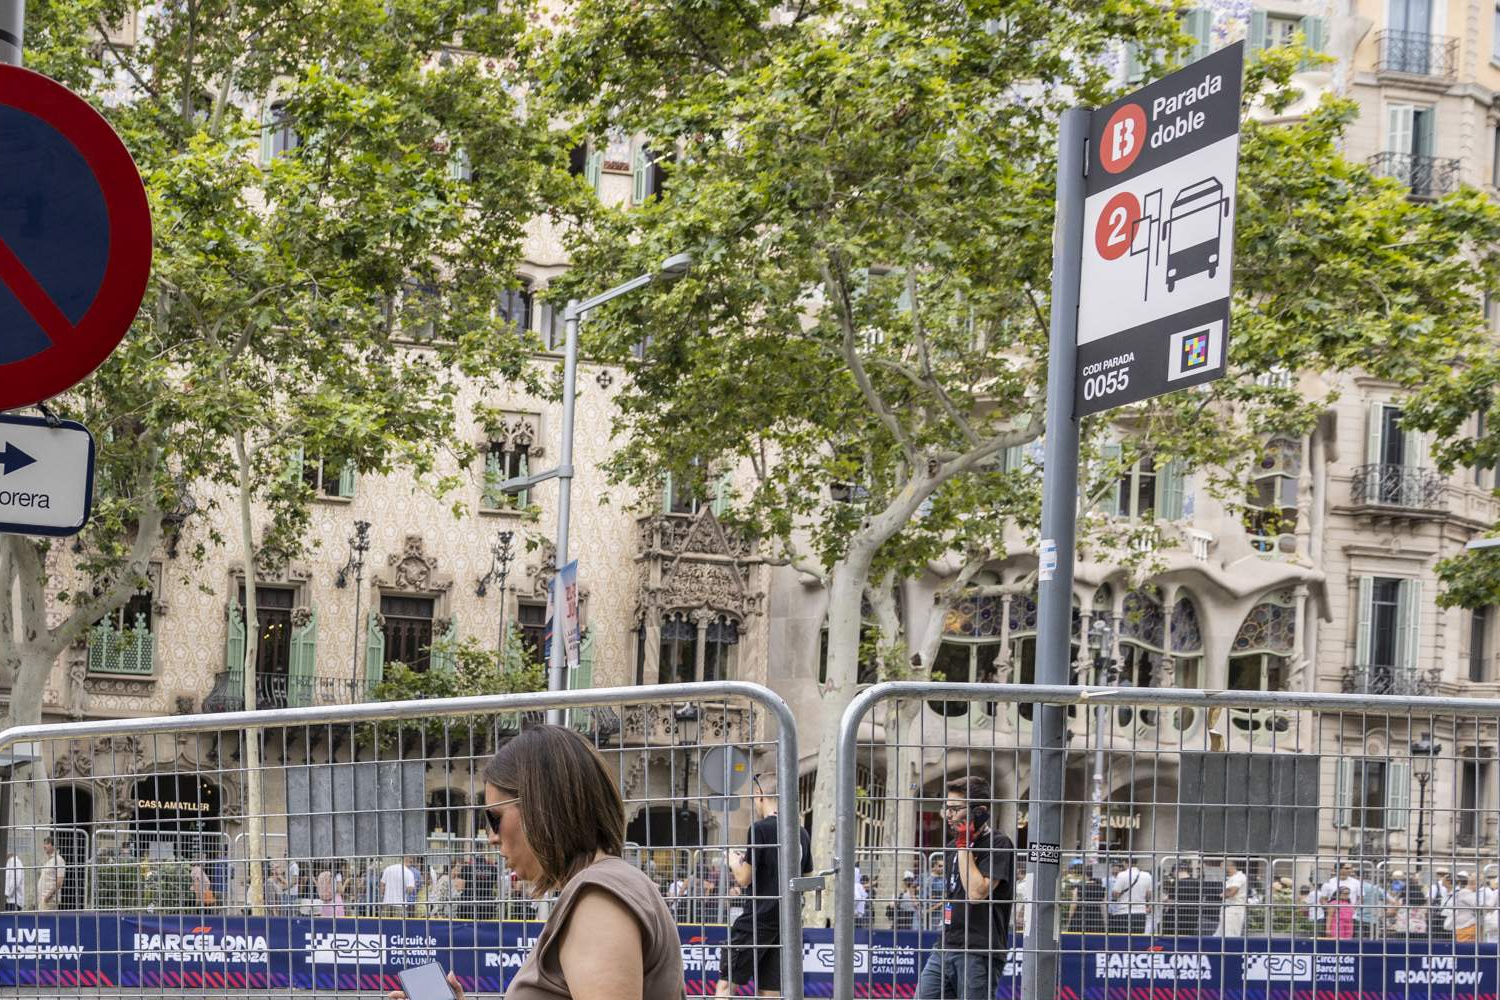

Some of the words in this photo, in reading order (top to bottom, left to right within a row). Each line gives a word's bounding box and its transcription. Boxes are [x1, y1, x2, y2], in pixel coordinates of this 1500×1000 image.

[1153, 73, 1222, 120] Parada
[1150, 111, 1205, 149] doble
[1112, 118, 1135, 161] B
[1107, 206, 1127, 246] 2
[1083, 361, 1102, 376] CODI
[1103, 352, 1135, 371] PARADA
[1084, 367, 1129, 401] 0055
[138, 800, 162, 809] CASA
[164, 801, 210, 812] AMATLLER
[1099, 814, 1141, 829] GAUDÍ
[6, 928, 50, 943] LIVE
[134, 933, 267, 952] BARCELONA
[390, 935, 423, 945] Circuit
[134, 951, 162, 961] FAN
[164, 951, 230, 962] FESTIVAL
[231, 952, 269, 963] 2024
[390, 957, 437, 966] CATALUNA
[872, 956, 915, 965] Barcelona
[1096, 953, 1211, 969] BARCELONA
[1422, 957, 1457, 970] LIVE
[1096, 969, 1120, 979] FAN
[1122, 969, 1175, 980] FESTIVAL
[1179, 969, 1212, 981] 2024
[1395, 970, 1483, 985] ROADSHOW
